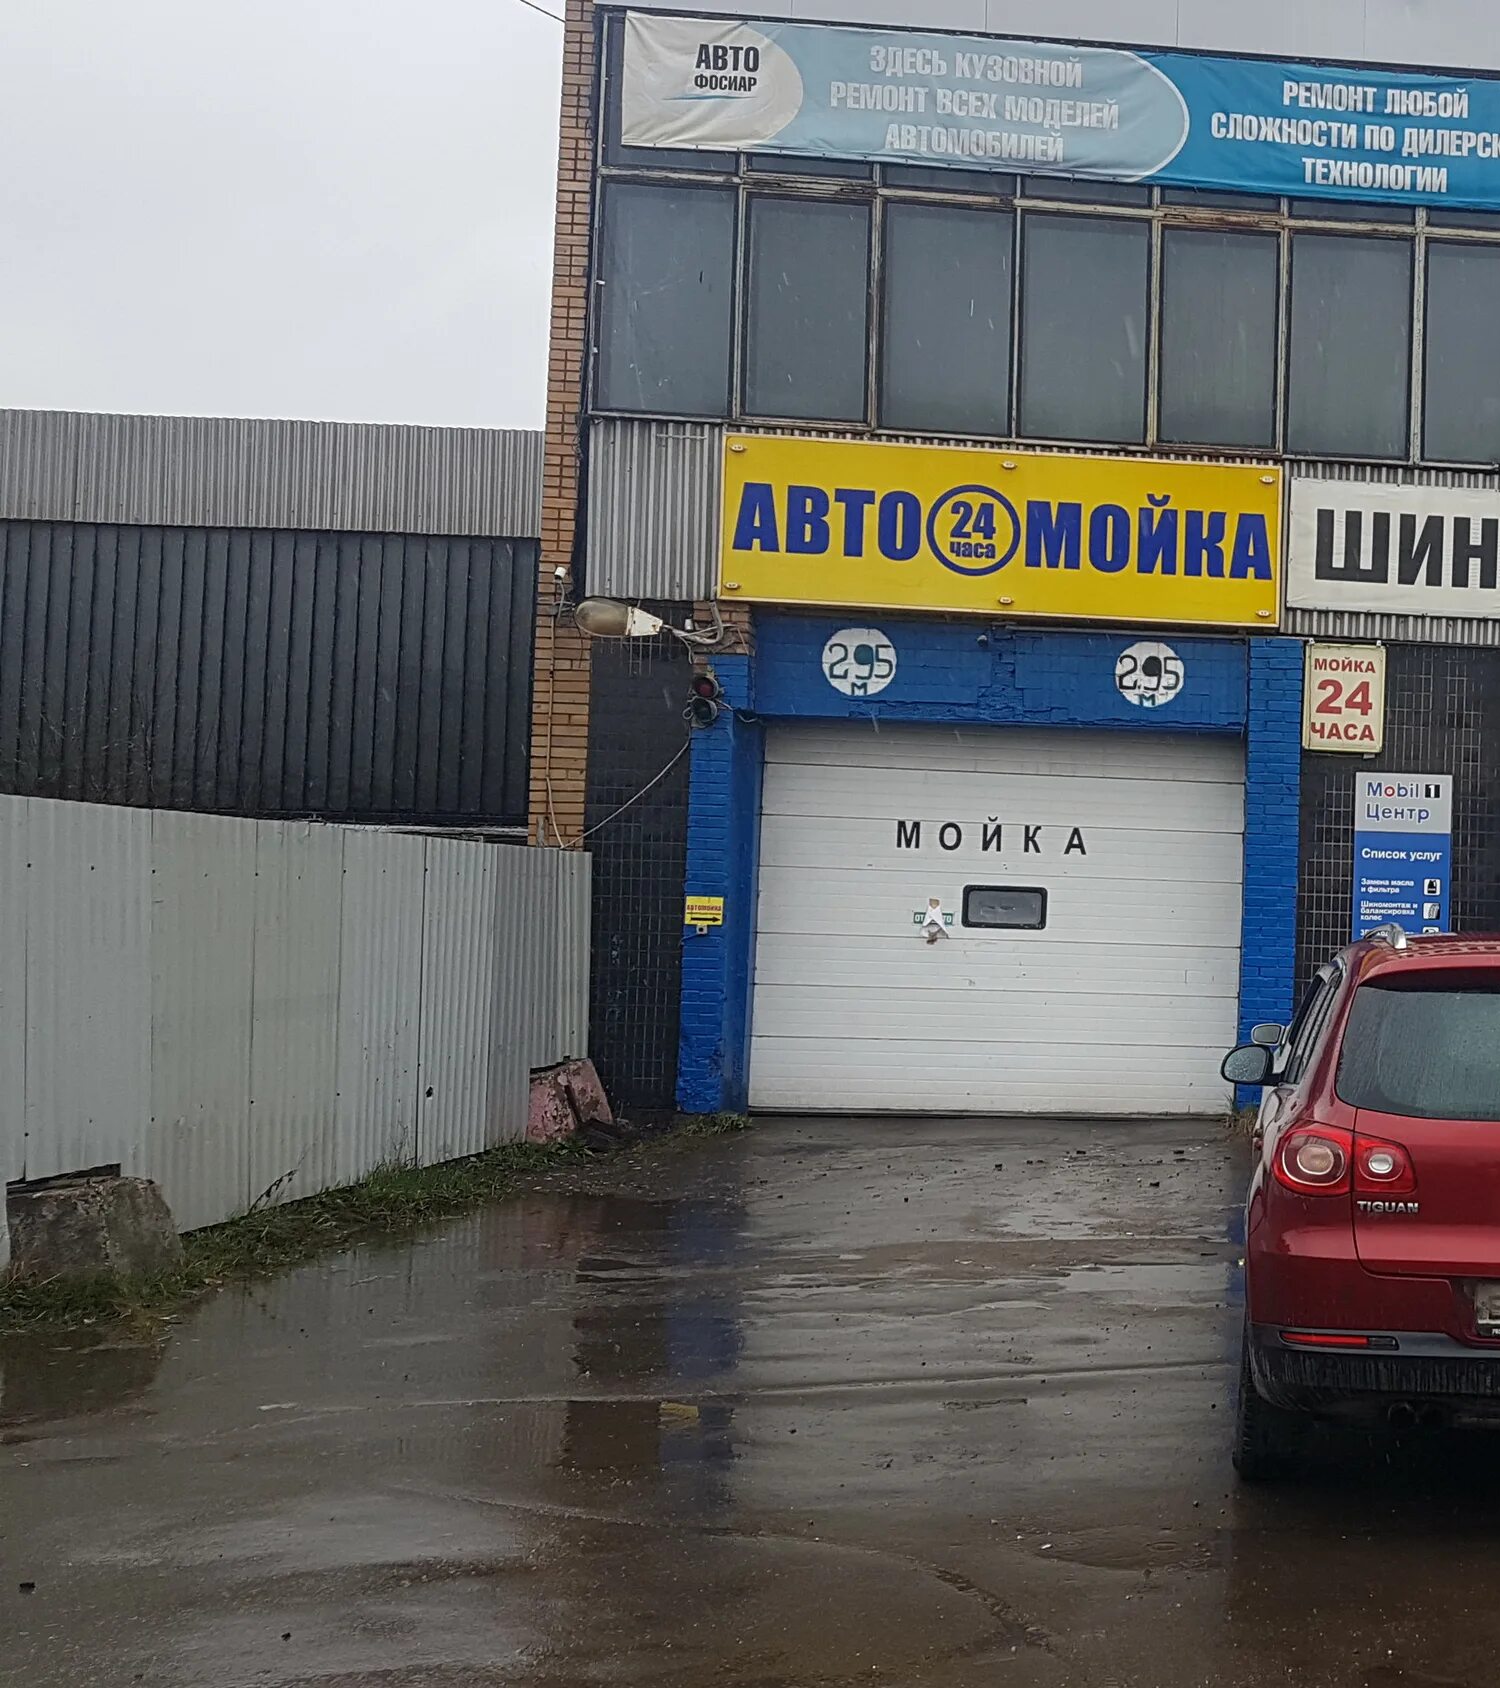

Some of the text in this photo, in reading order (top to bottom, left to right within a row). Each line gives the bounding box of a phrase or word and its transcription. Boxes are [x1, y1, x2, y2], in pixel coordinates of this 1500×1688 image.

[695, 44, 760, 72] АВТО
[869, 44, 1082, 88] ЗДЕСЬ КУЗОВНОЙ
[694, 72, 757, 93] ФОСИАР
[830, 81, 1120, 130] РЕМОНТ ВСЕХ МОДЕЛЕЙ
[1283, 80, 1469, 119] РЕМОНТ ЛЮБОЙ
[885, 123, 1064, 162] АВТОМОБИЛЕЙ
[1211, 114, 1357, 149] СЛОЖНОСТИ
[1364, 126, 1395, 152] ПО
[1302, 157, 1448, 193] ТЕХНОЛОГИИ
[949, 499, 997, 540] 24
[732, 482, 1273, 581] АВТО МОЙКА
[949, 540, 997, 561] часа
[1313, 657, 1376, 674] МОЙКА
[1315, 678, 1374, 717] 24
[1310, 722, 1375, 742] ЧАСА
[1366, 781, 1440, 799] Mobil 1
[1366, 803, 1430, 823] Центр
[896, 816, 1088, 856] МОЙКА
[1361, 848, 1443, 862] Список услуг
[1360, 878, 1415, 887] Замена масла
[1367, 886, 1400, 894] фильтра
[1360, 900, 1411, 909] Шиномонтаж
[1360, 907, 1415, 916] балансировка
[1356, 1200, 1419, 1214] TIGUAN
